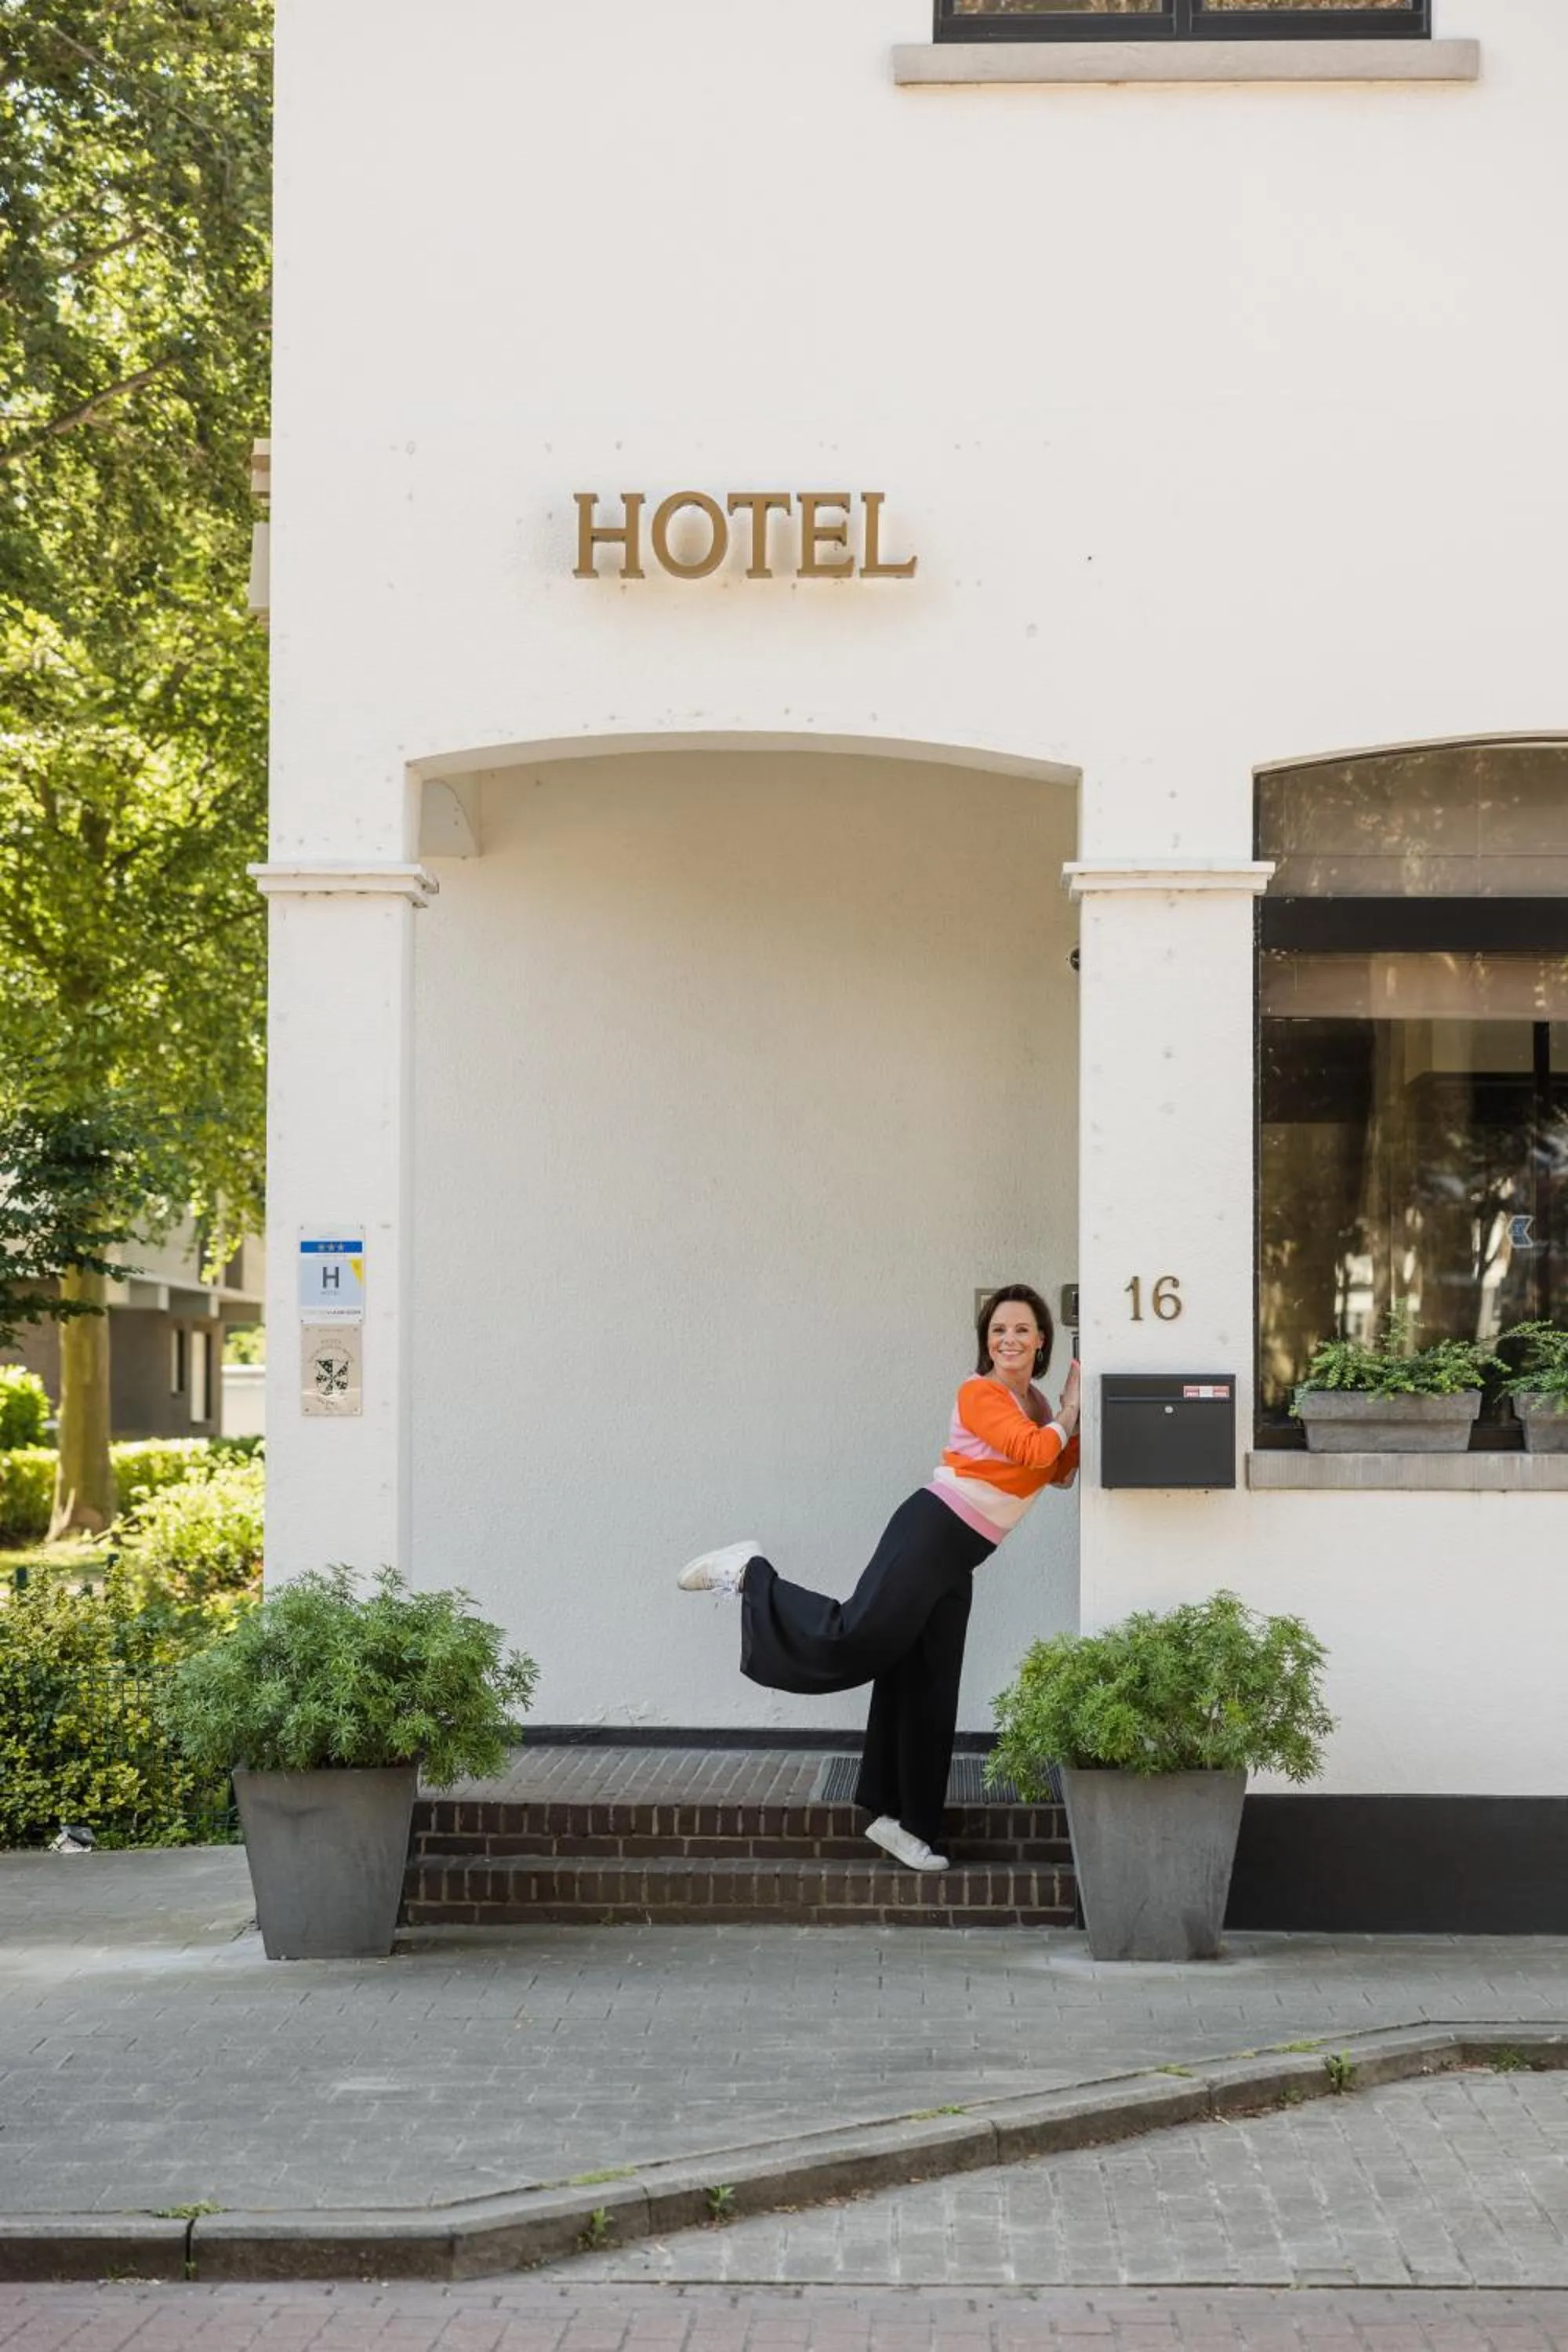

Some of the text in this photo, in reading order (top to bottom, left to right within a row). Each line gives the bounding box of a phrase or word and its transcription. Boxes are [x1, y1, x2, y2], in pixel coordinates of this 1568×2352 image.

[573, 491, 917, 579] HOTEL
[322, 1266, 339, 1288] H
[1124, 1276, 1182, 1321] 16
